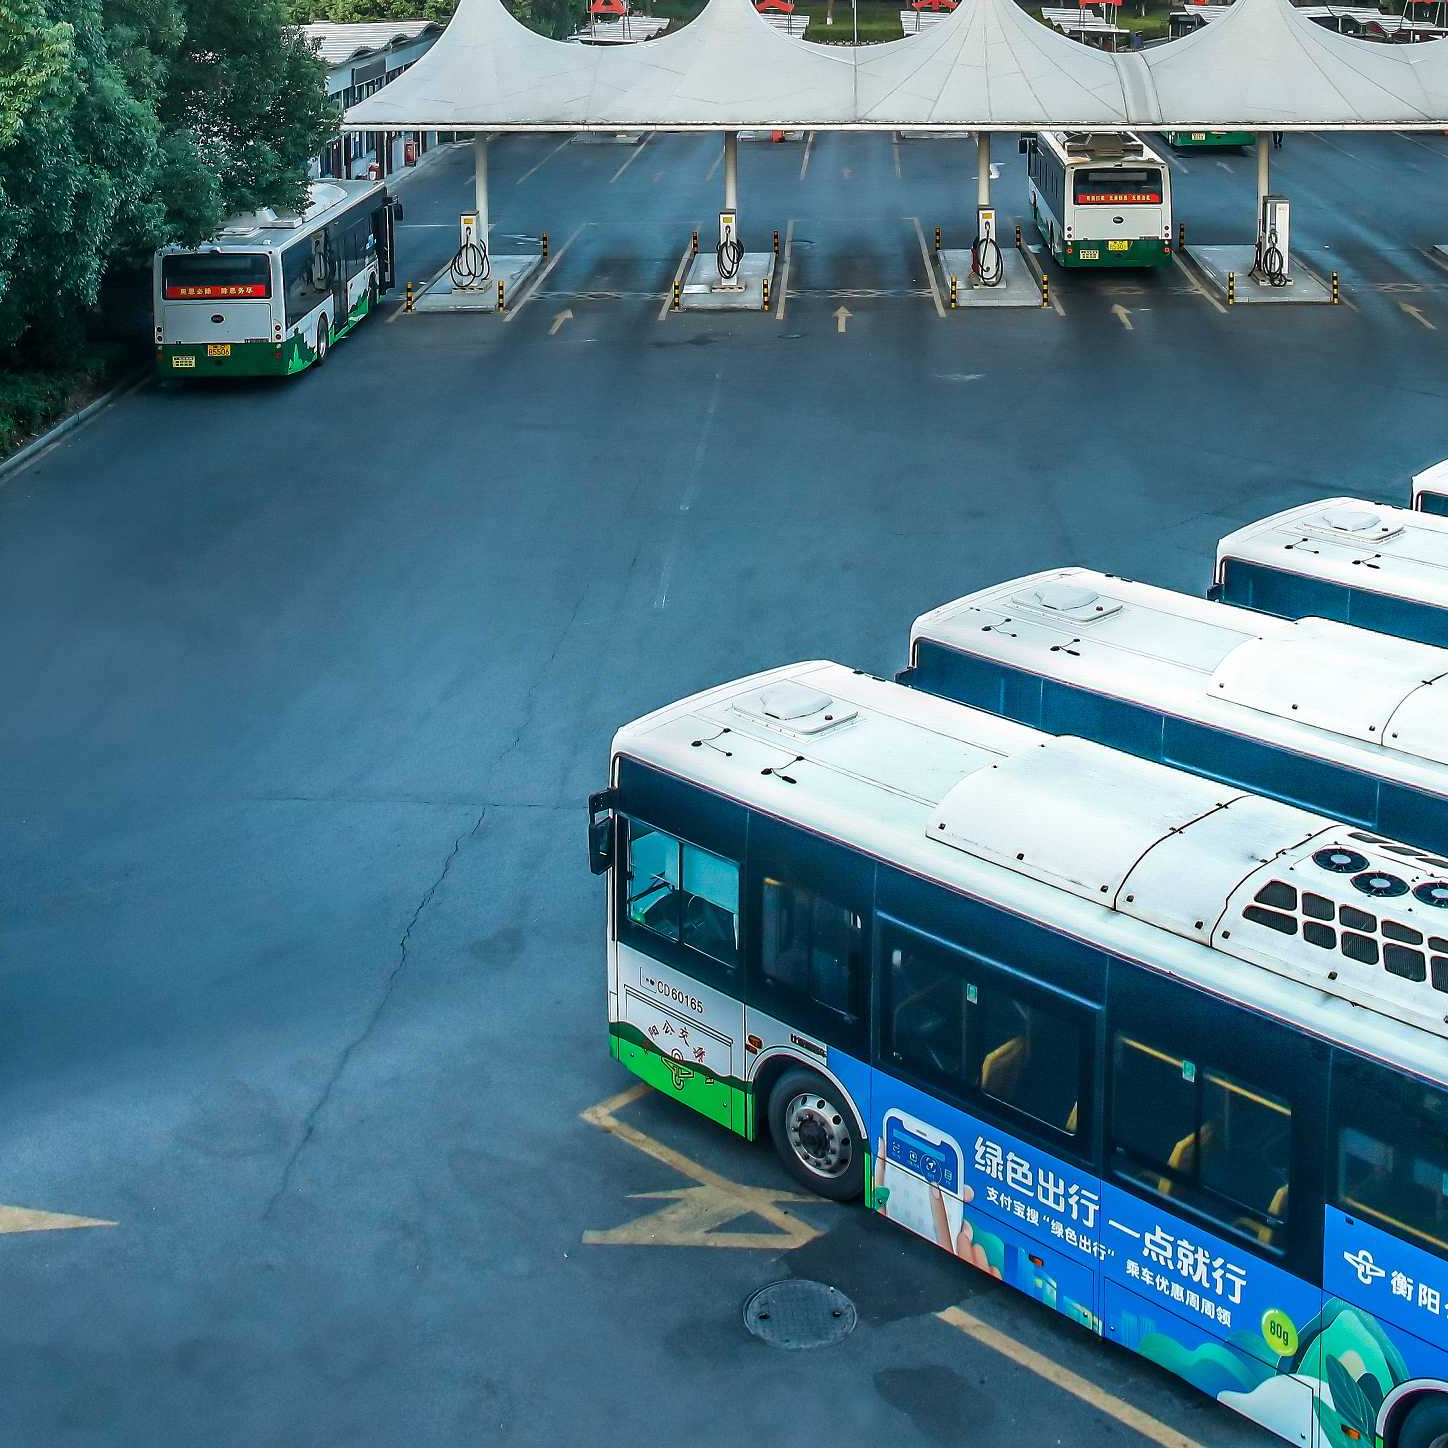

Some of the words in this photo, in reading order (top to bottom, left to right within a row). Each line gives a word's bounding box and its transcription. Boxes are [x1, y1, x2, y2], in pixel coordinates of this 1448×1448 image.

[974, 1135, 1100, 1229] 绿色出行
[1108, 1217, 1248, 1305] 一点就行
[1269, 1318, 1290, 1346] 80g
